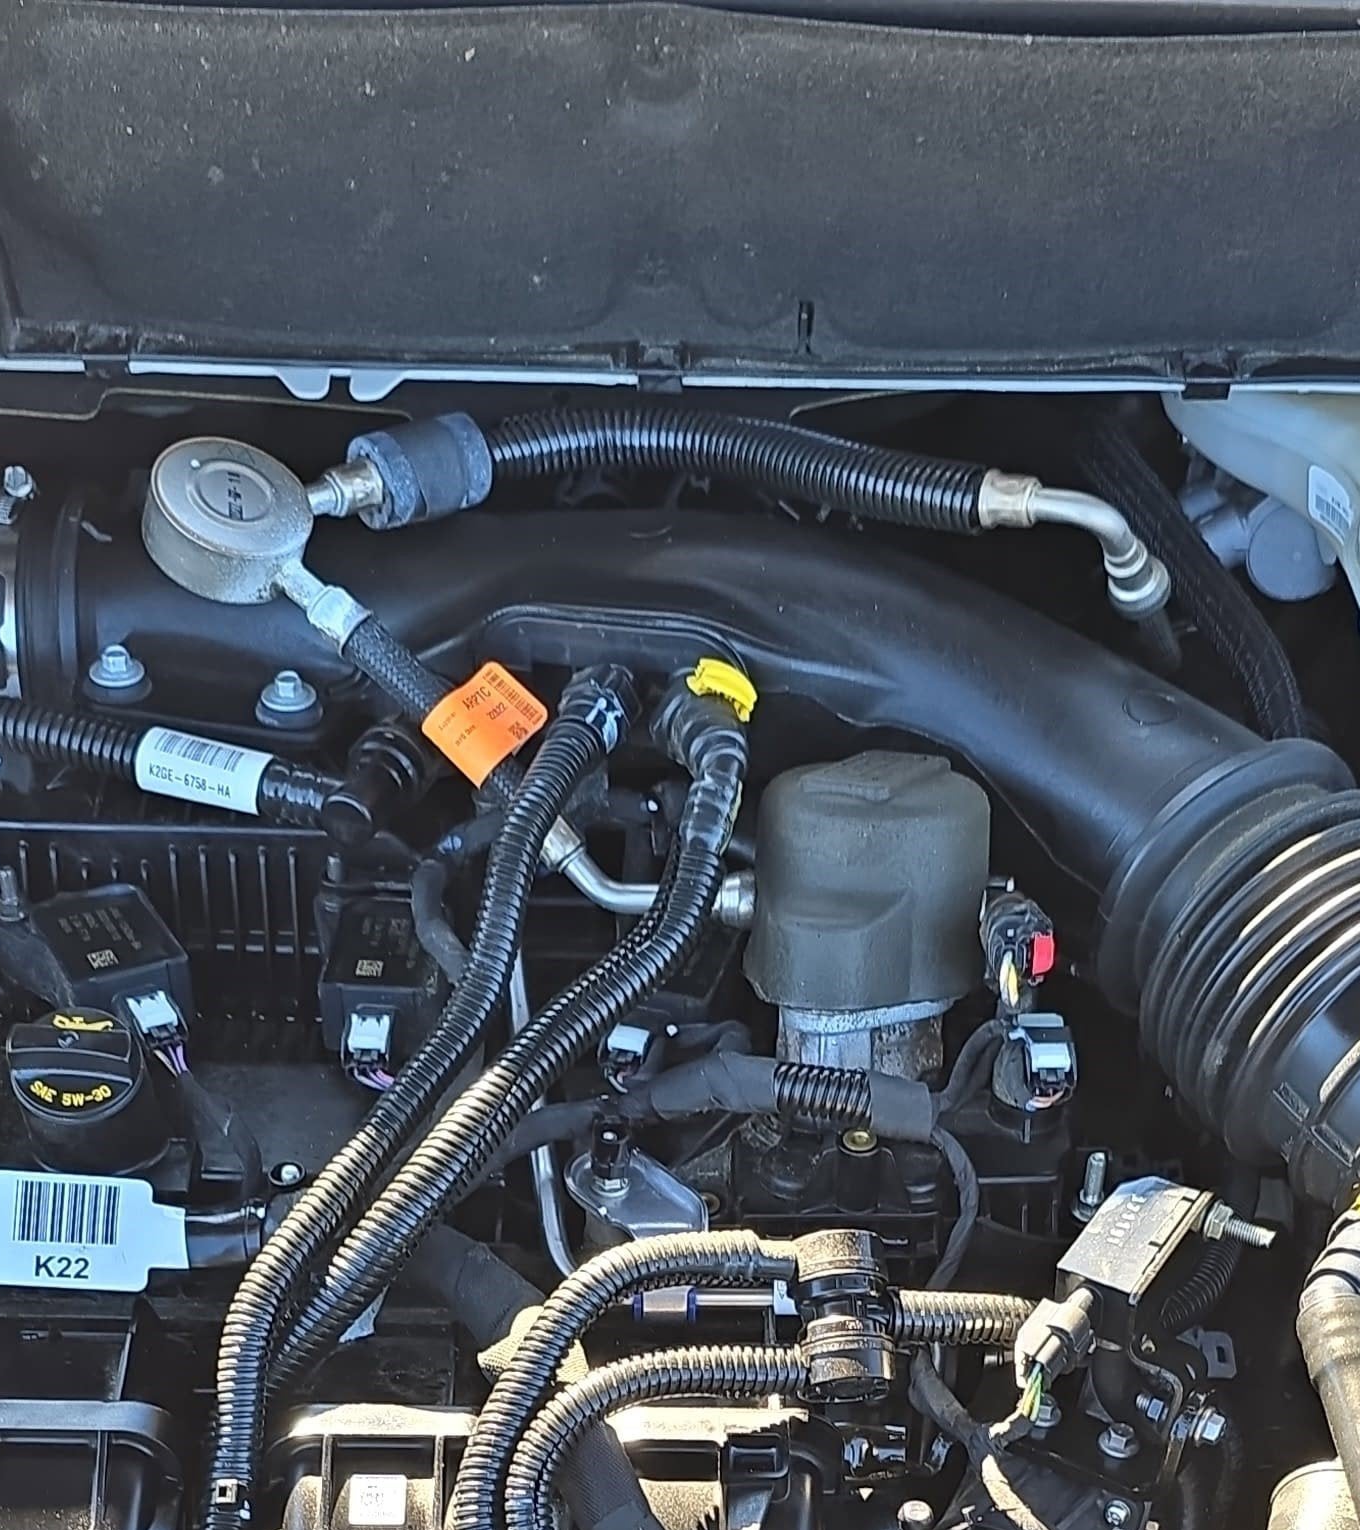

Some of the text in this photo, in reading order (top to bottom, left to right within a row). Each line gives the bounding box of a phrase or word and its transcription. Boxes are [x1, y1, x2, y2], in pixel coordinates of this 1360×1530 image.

[149, 763, 231, 799] K2GE-6758-HA
[30, 1080, 112, 1107] SAE 5W-30
[34, 1255, 89, 1279] K22
